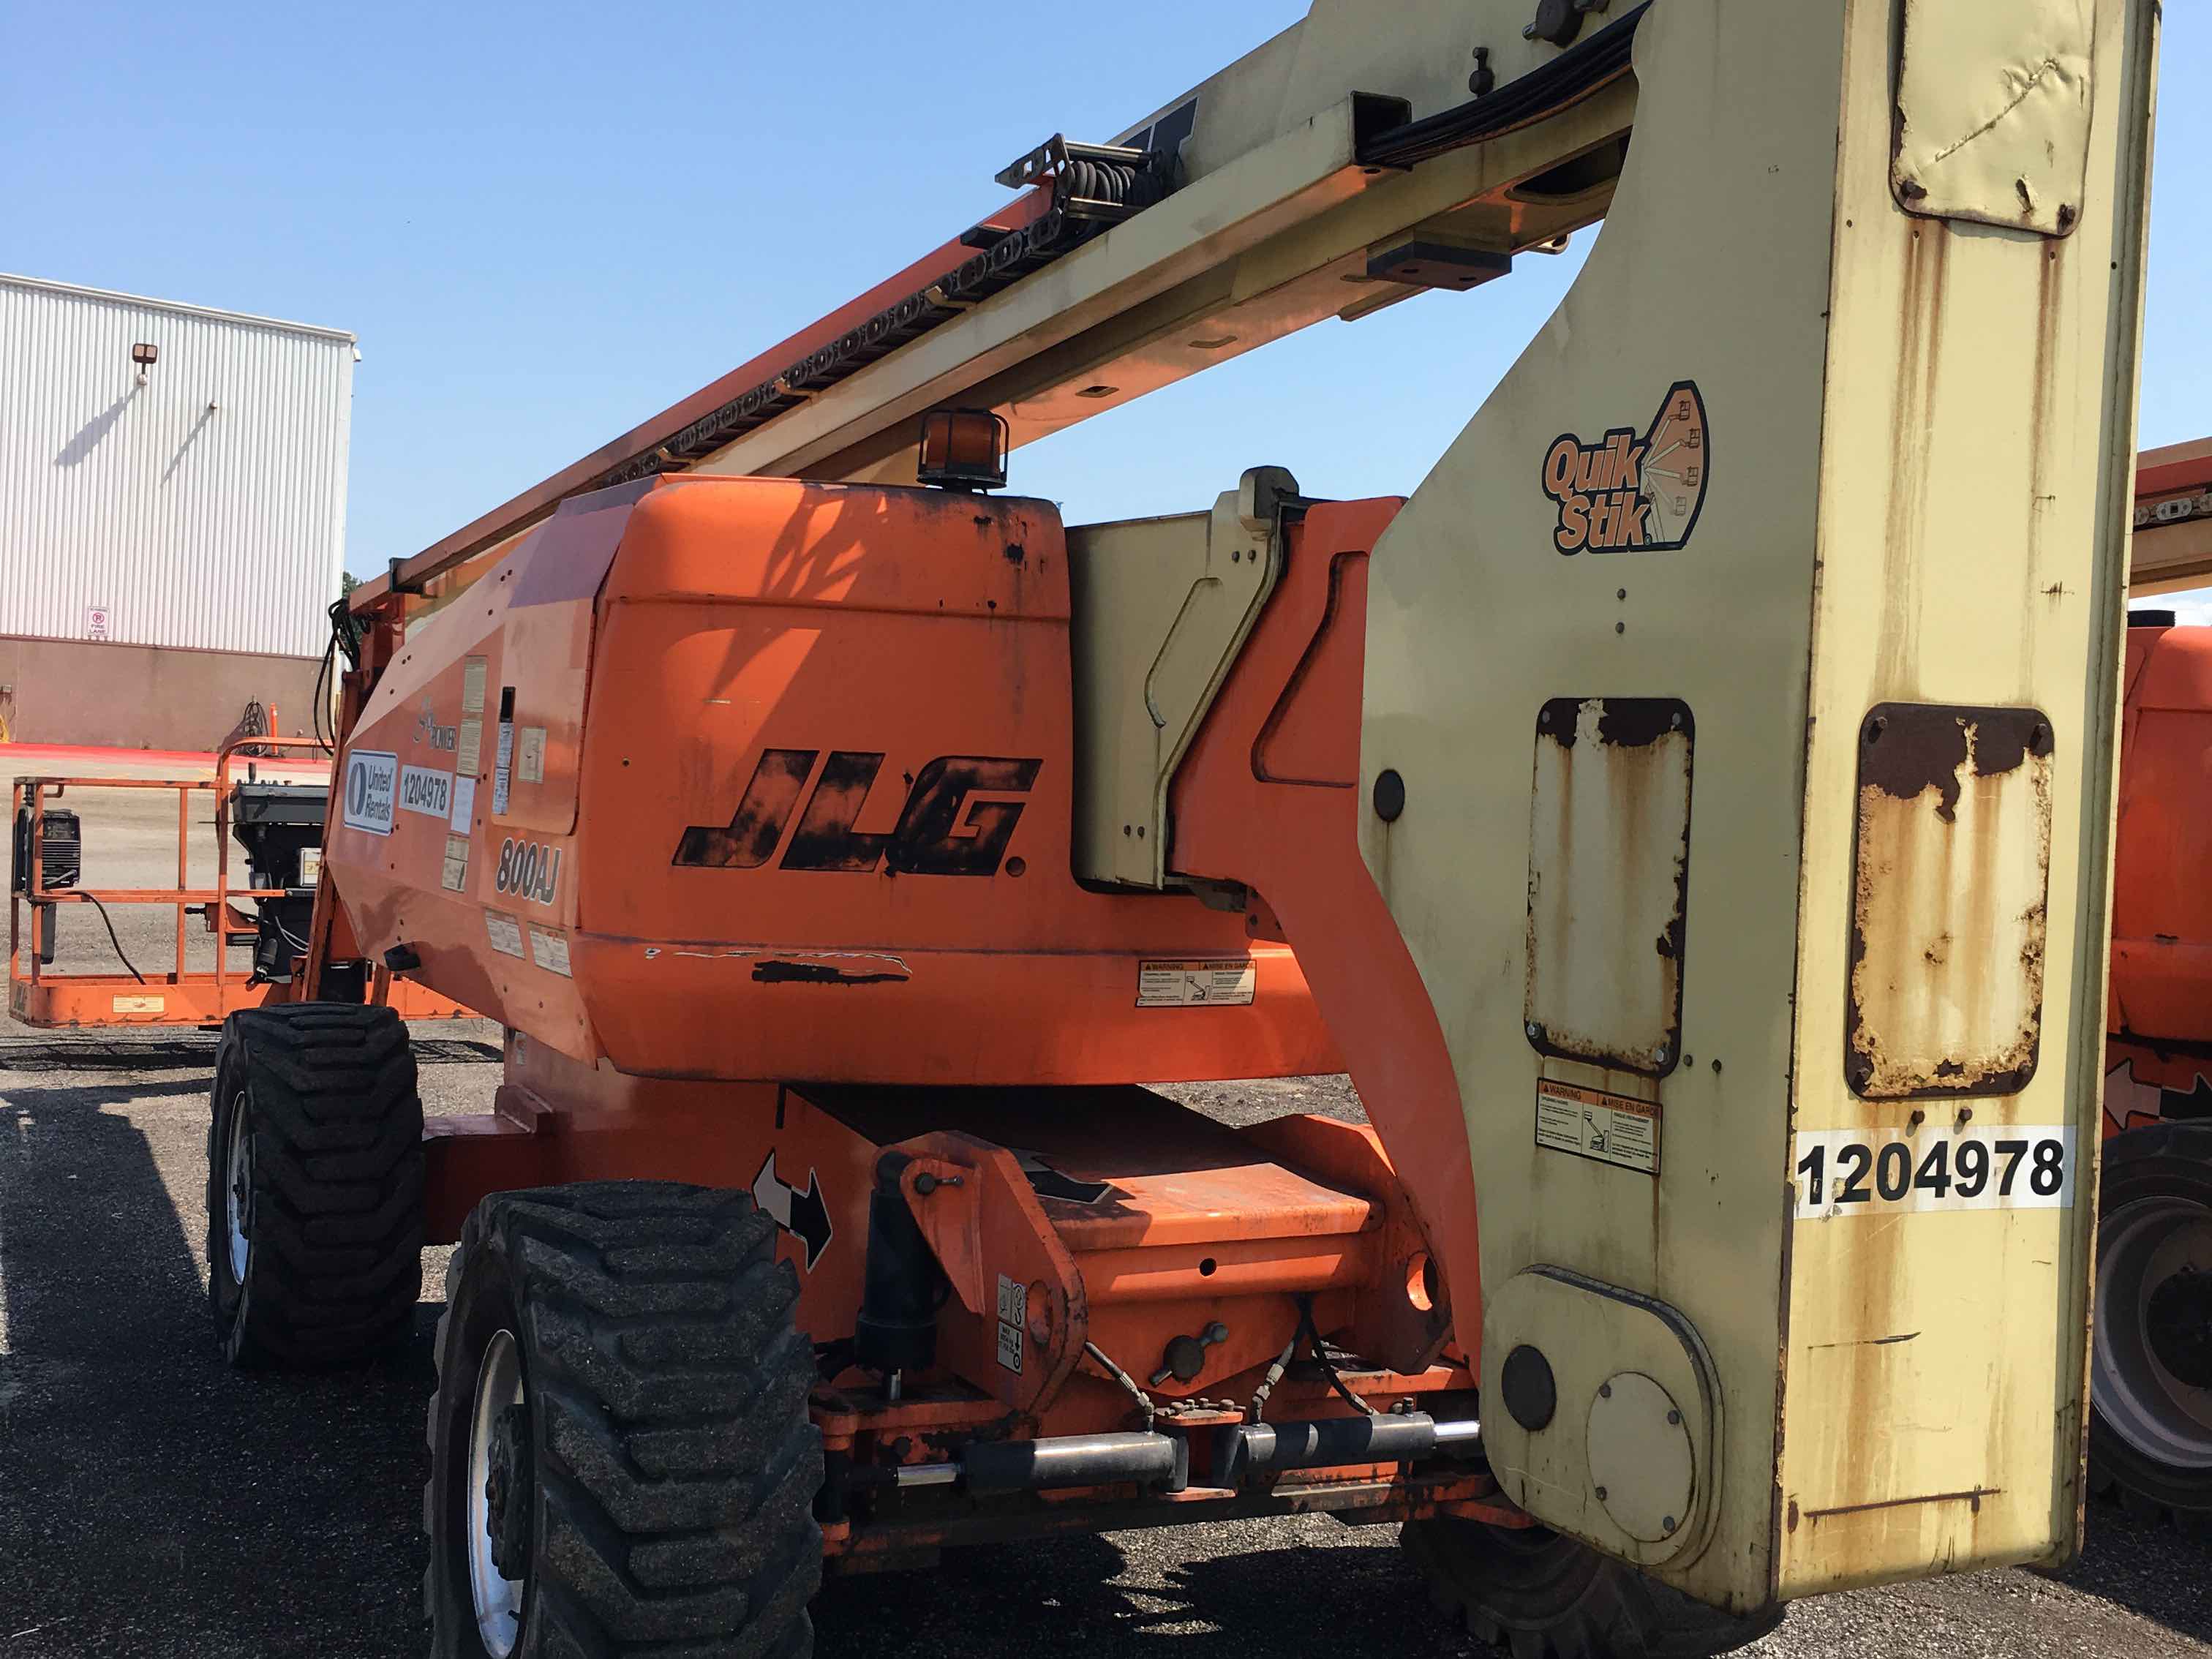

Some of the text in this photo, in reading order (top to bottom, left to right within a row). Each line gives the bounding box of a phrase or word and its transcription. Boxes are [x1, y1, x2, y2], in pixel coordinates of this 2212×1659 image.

[1544, 434, 1645, 500] Quik
[1556, 491, 1651, 549] Stik
[368, 766, 394, 792] United
[404, 772, 448, 811] 1204978
[364, 794, 391, 822] Rentals
[671, 748, 1044, 877] JLG
[497, 837, 562, 906] 800AJ
[1549, 1084, 1581, 1100] WARNING
[1609, 1098, 1624, 1110] MISE
[1625, 1102, 1635, 1112] EN
[1798, 1139, 2064, 1205] 1204978
